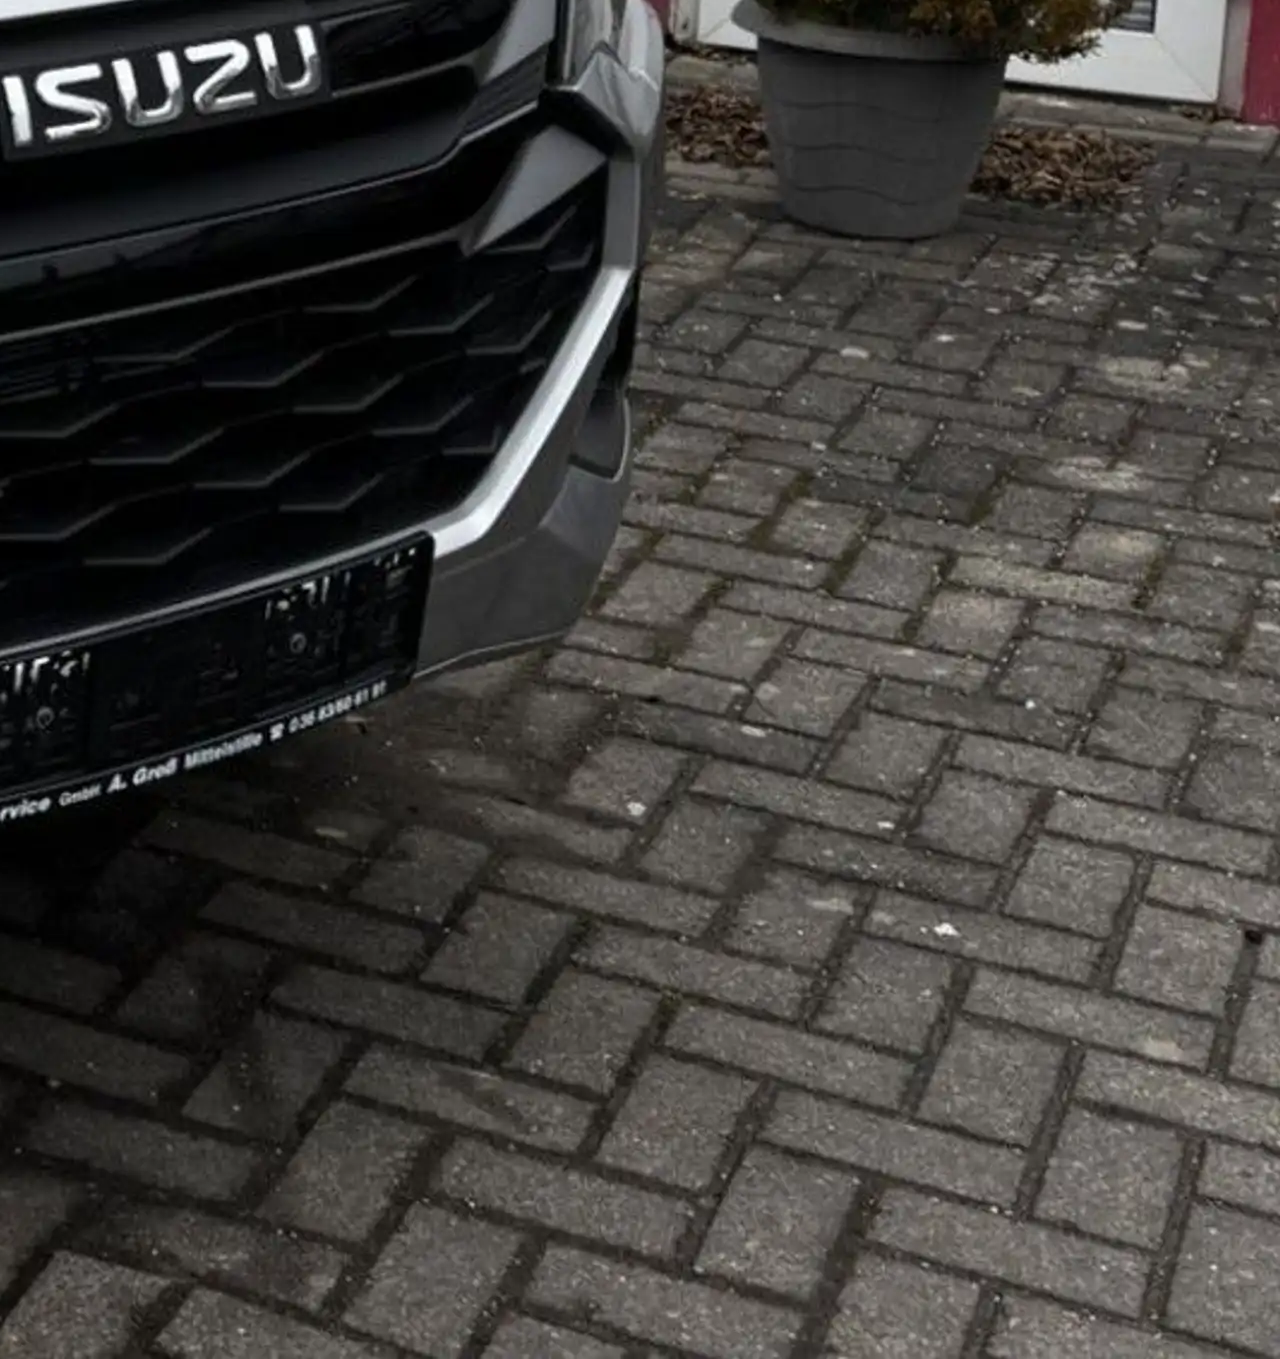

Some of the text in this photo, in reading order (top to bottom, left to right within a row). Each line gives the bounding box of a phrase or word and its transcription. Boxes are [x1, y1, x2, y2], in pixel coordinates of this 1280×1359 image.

[2, 24, 322, 148] ISUZU
[58, 783, 102, 807] GmbH
[105, 772, 128, 794] A.
[132, 756, 179, 787] Groß
